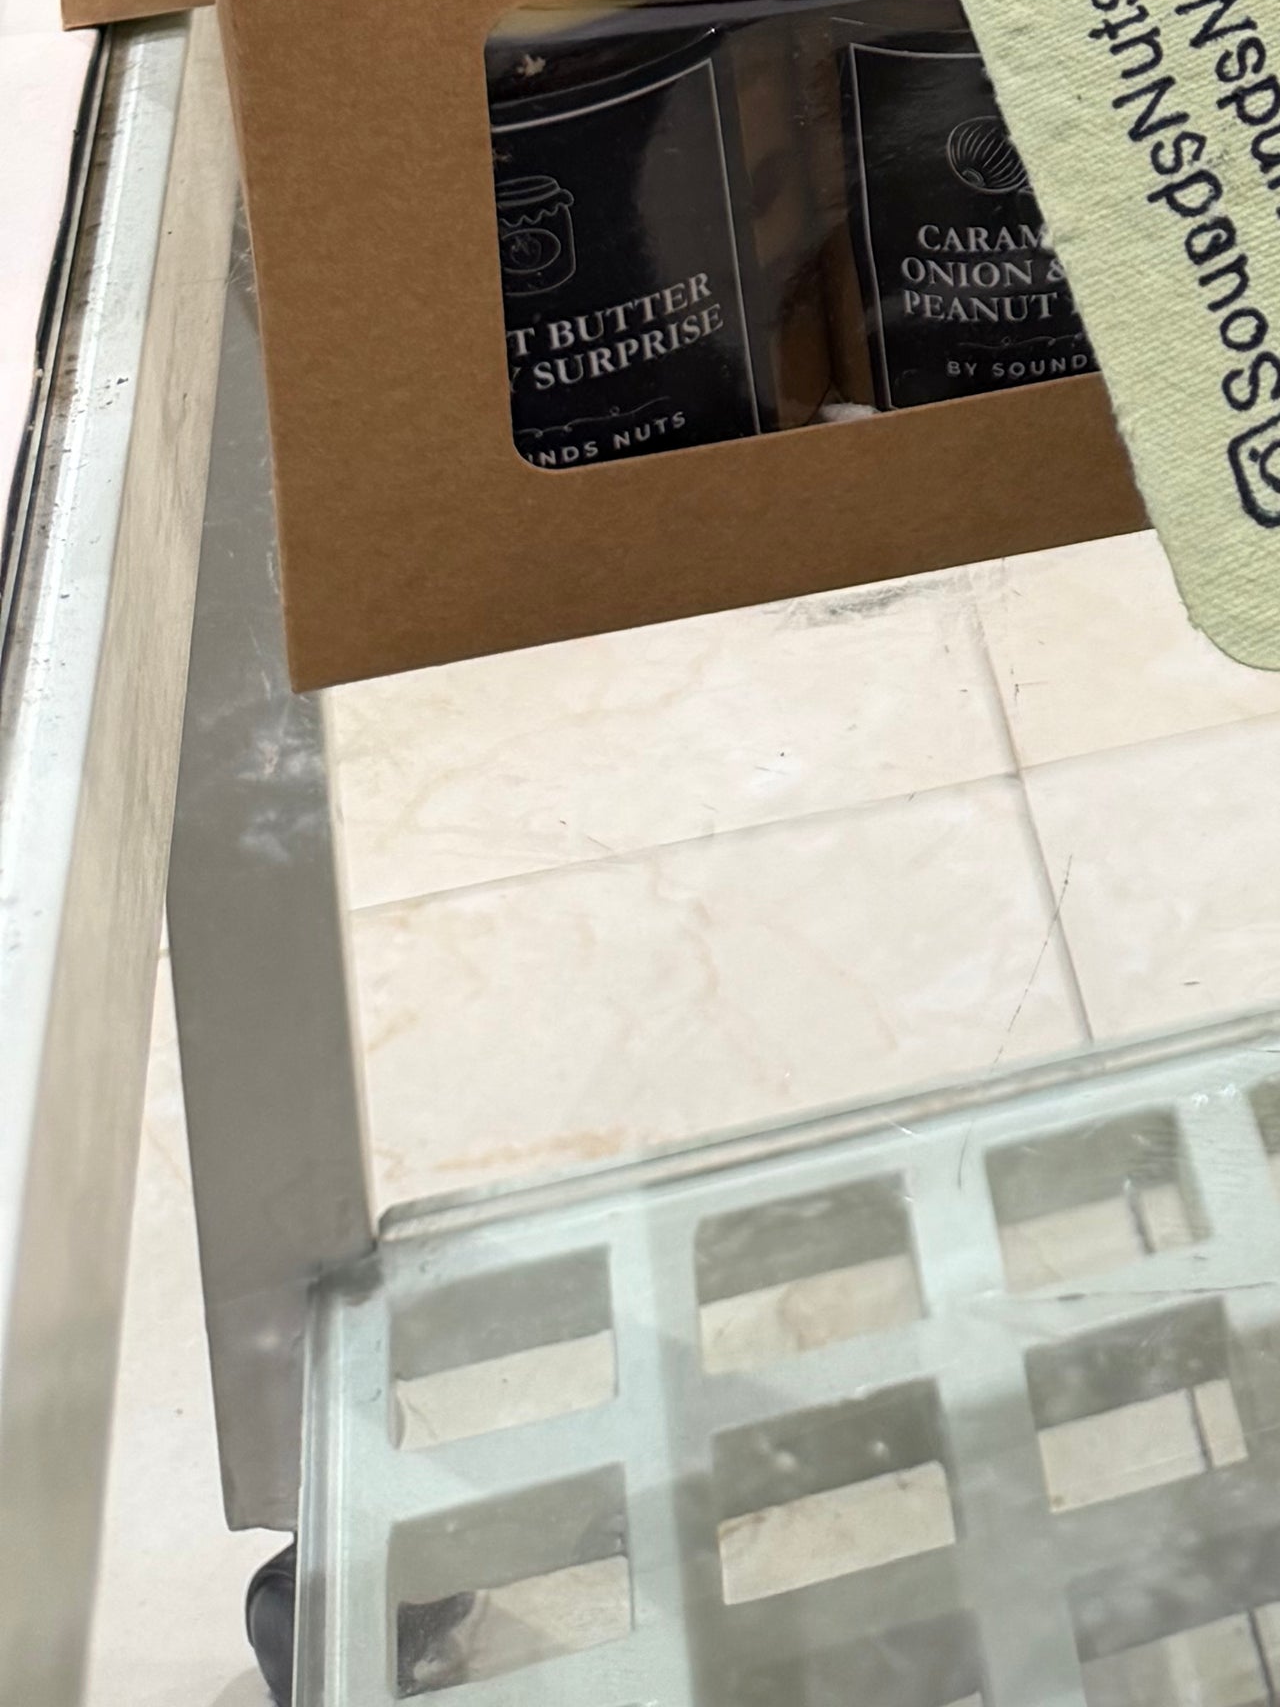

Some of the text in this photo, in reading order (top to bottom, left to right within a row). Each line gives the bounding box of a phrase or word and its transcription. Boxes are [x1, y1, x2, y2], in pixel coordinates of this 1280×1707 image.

[901, 257, 1033, 288] ONION
[547, 272, 712, 350] BUTTER
[904, 290, 1058, 322] PEANUT
[532, 303, 724, 390] SURPRISE
[947, 361, 977, 376] BY
[613, 411, 686, 450] NUTS
